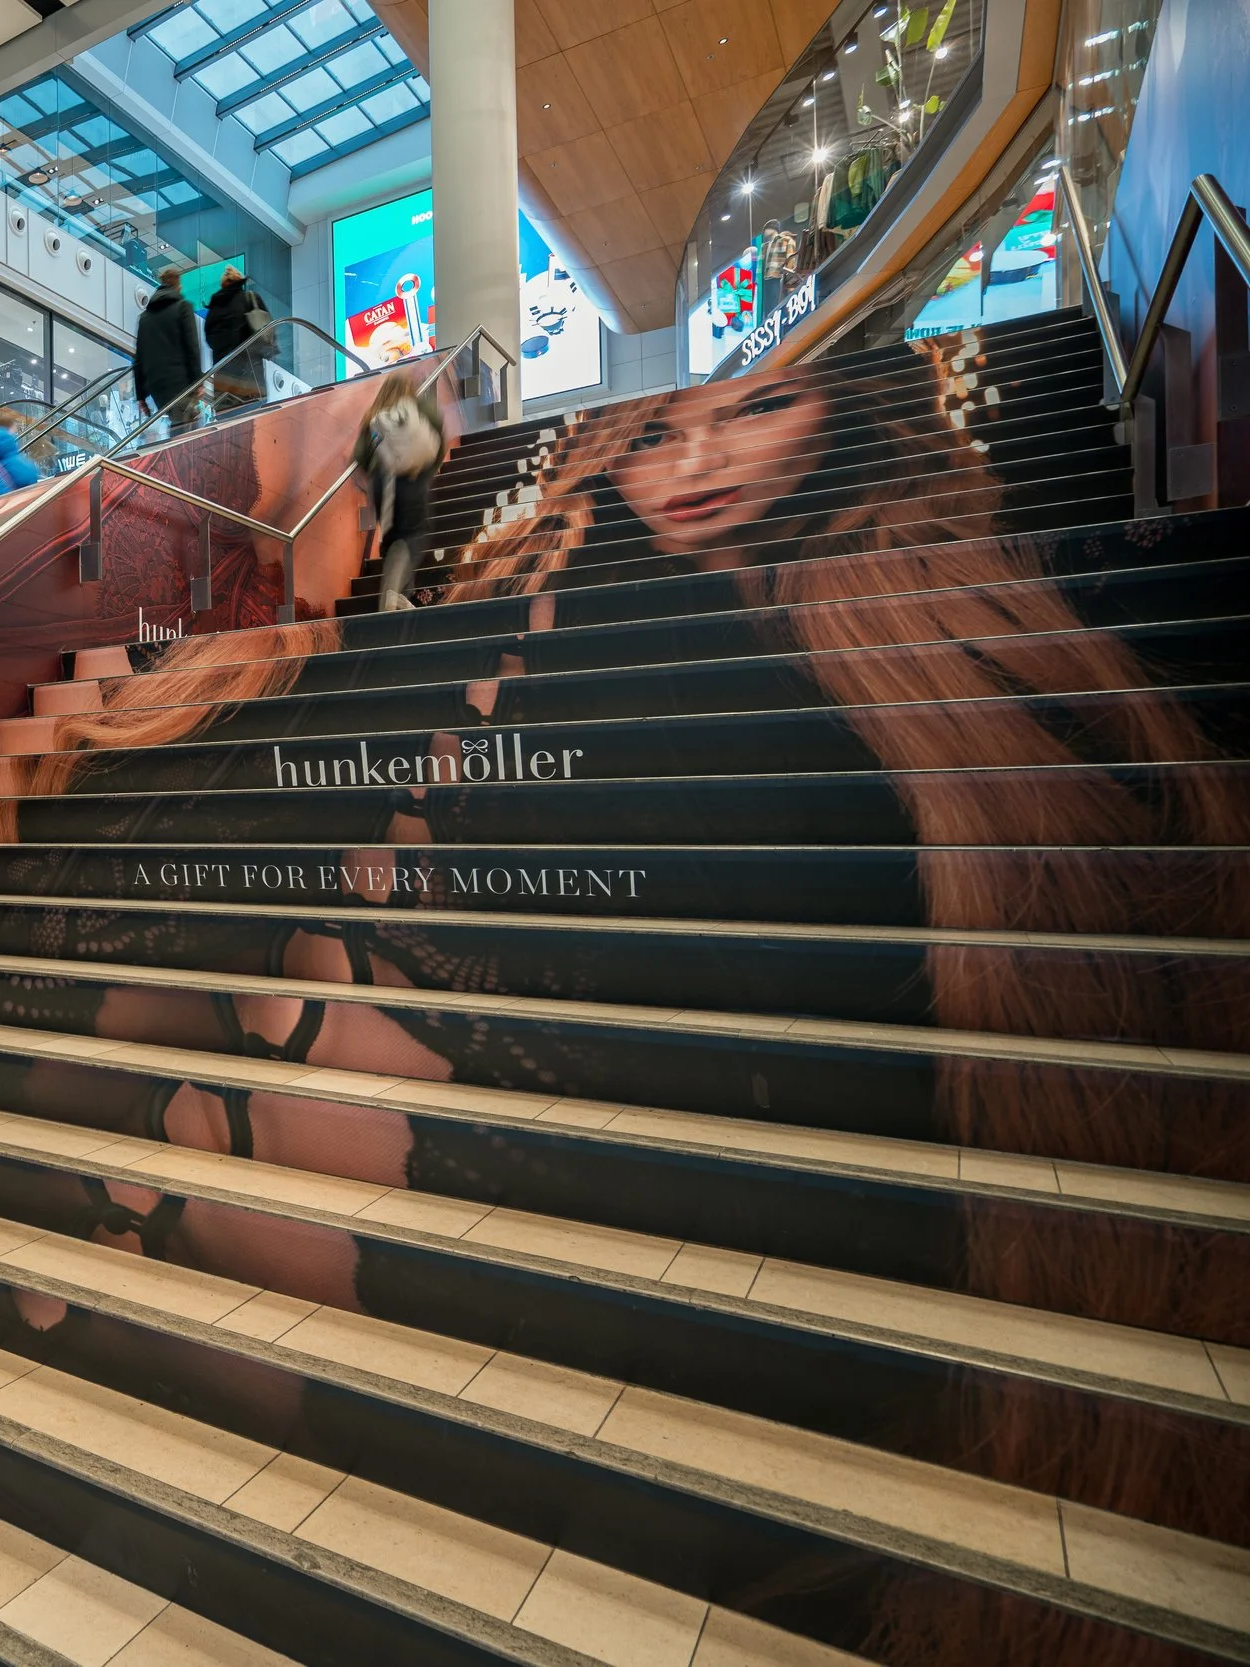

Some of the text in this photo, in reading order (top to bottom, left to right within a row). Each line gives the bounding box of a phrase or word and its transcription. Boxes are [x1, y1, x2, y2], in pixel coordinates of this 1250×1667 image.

[364, 302, 395, 323] CATAN
[274, 733, 583, 787] hunkemöller
[134, 863, 646, 898] A GIFT FOR EVERY MOMENT
